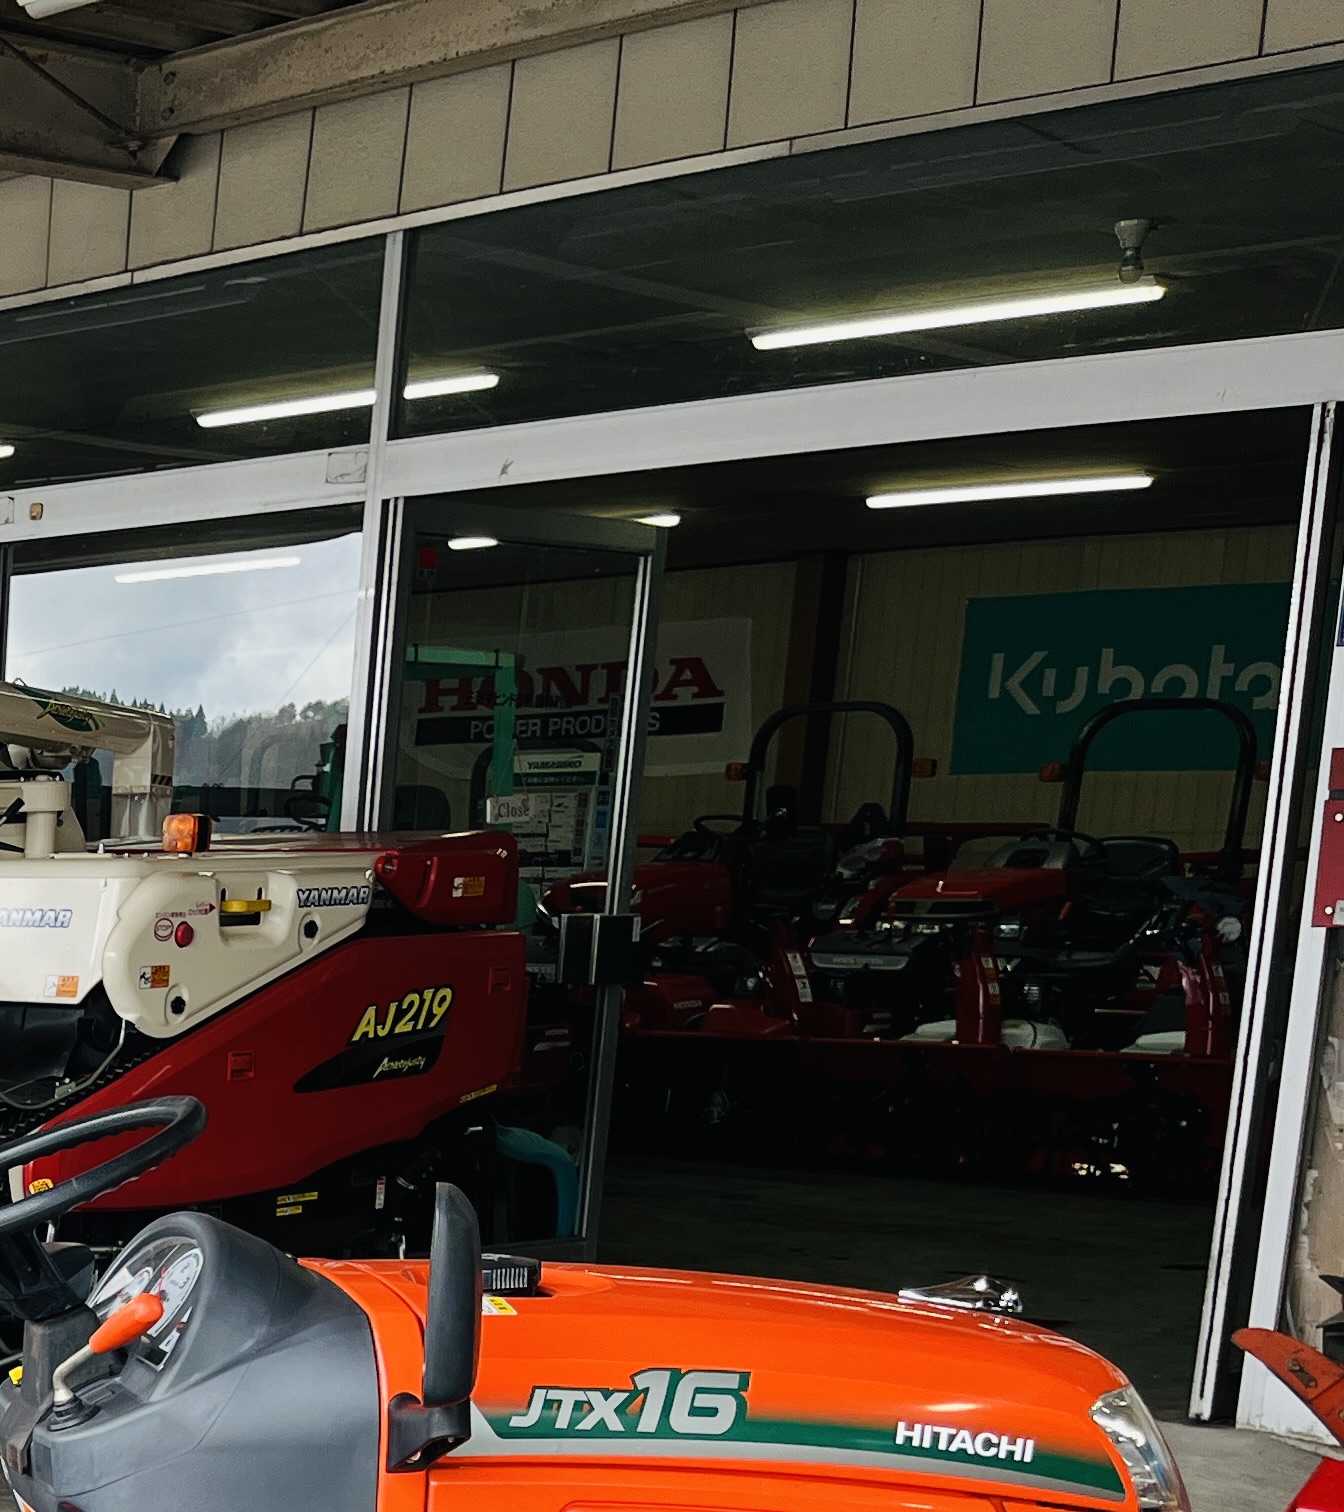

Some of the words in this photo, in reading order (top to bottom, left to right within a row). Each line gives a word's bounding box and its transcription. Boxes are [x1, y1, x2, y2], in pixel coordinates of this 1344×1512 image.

[988, 644, 1283, 715] Kubota
[497, 801, 530, 818] Close
[297, 886, 371, 908] YANMAR
[351, 986, 454, 1042] AJ219
[509, 1369, 750, 1435] JTX16
[895, 1421, 1035, 1462] HITACHI
